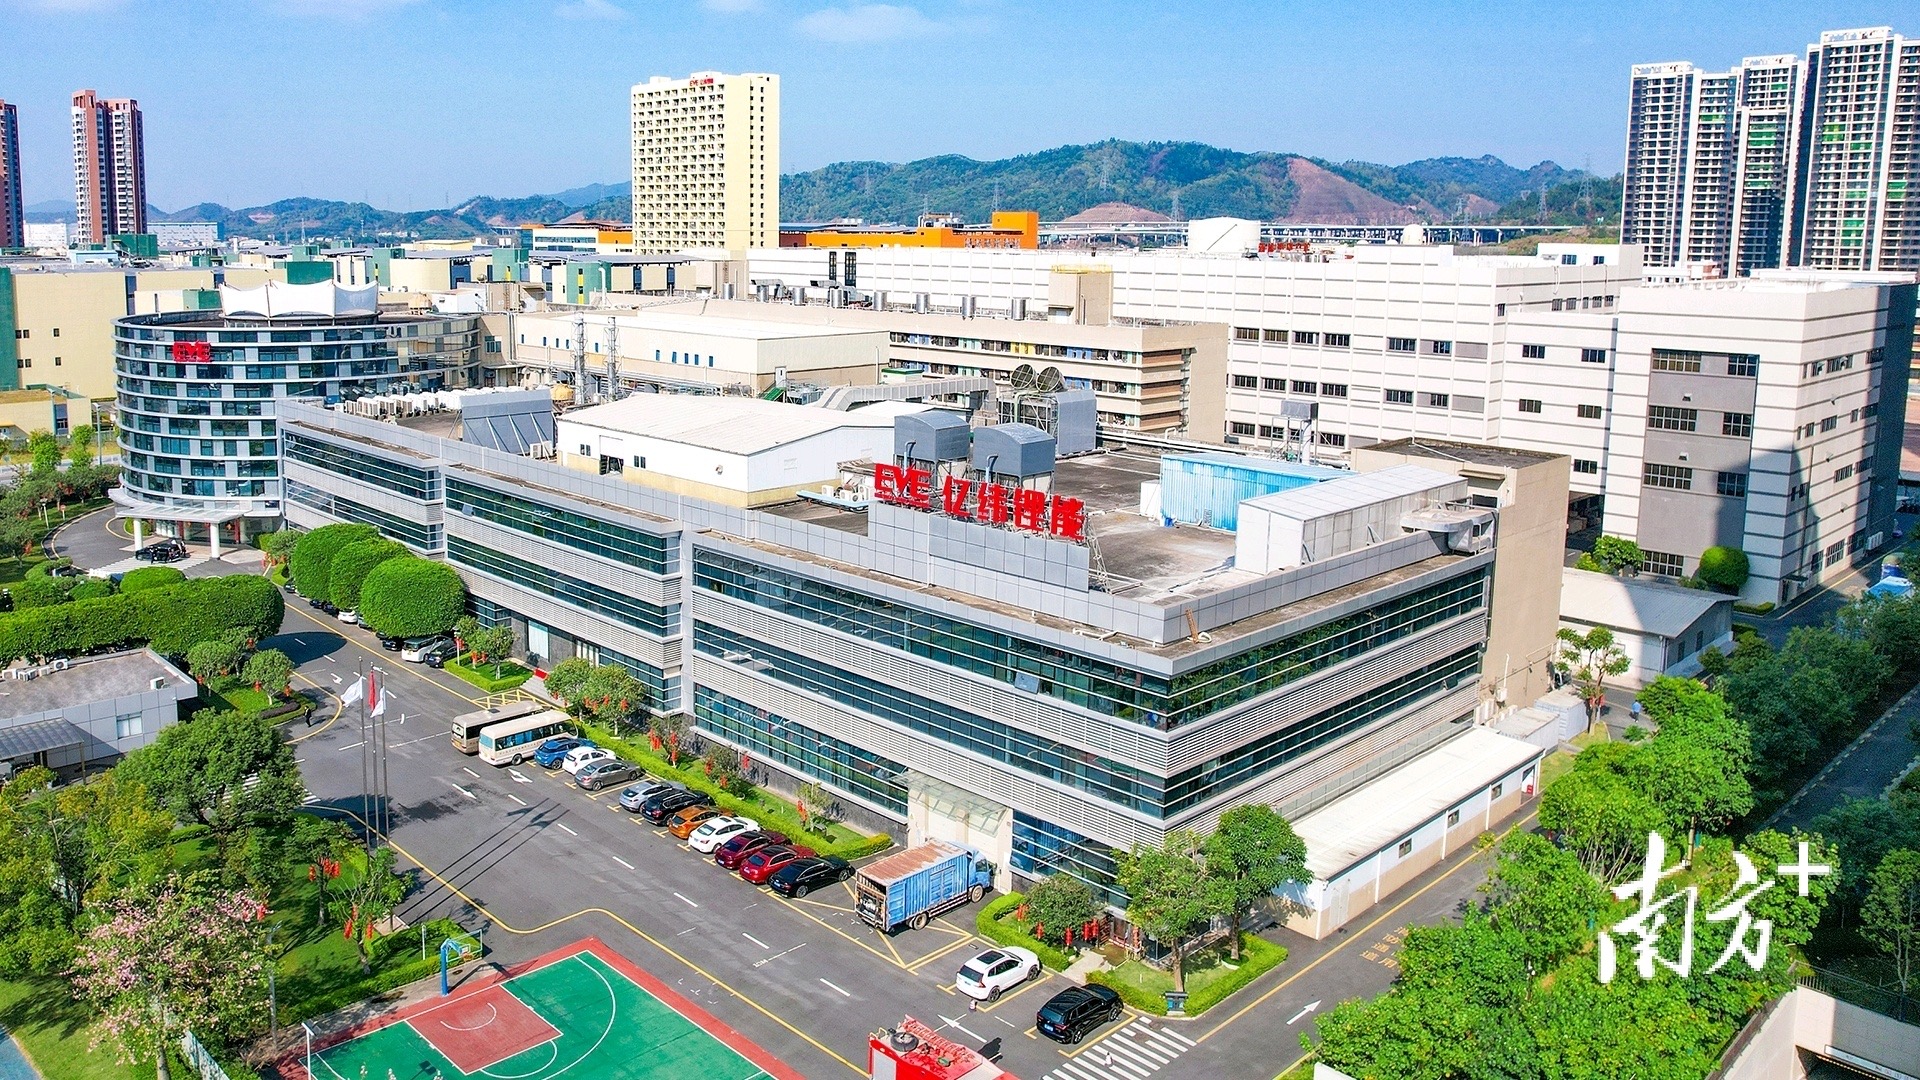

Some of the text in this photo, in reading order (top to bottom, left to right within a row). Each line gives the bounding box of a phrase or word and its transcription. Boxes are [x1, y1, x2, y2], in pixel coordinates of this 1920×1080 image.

[173, 341, 210, 362] EVE
[874, 463, 1085, 541] EVE 亿纬锂能
